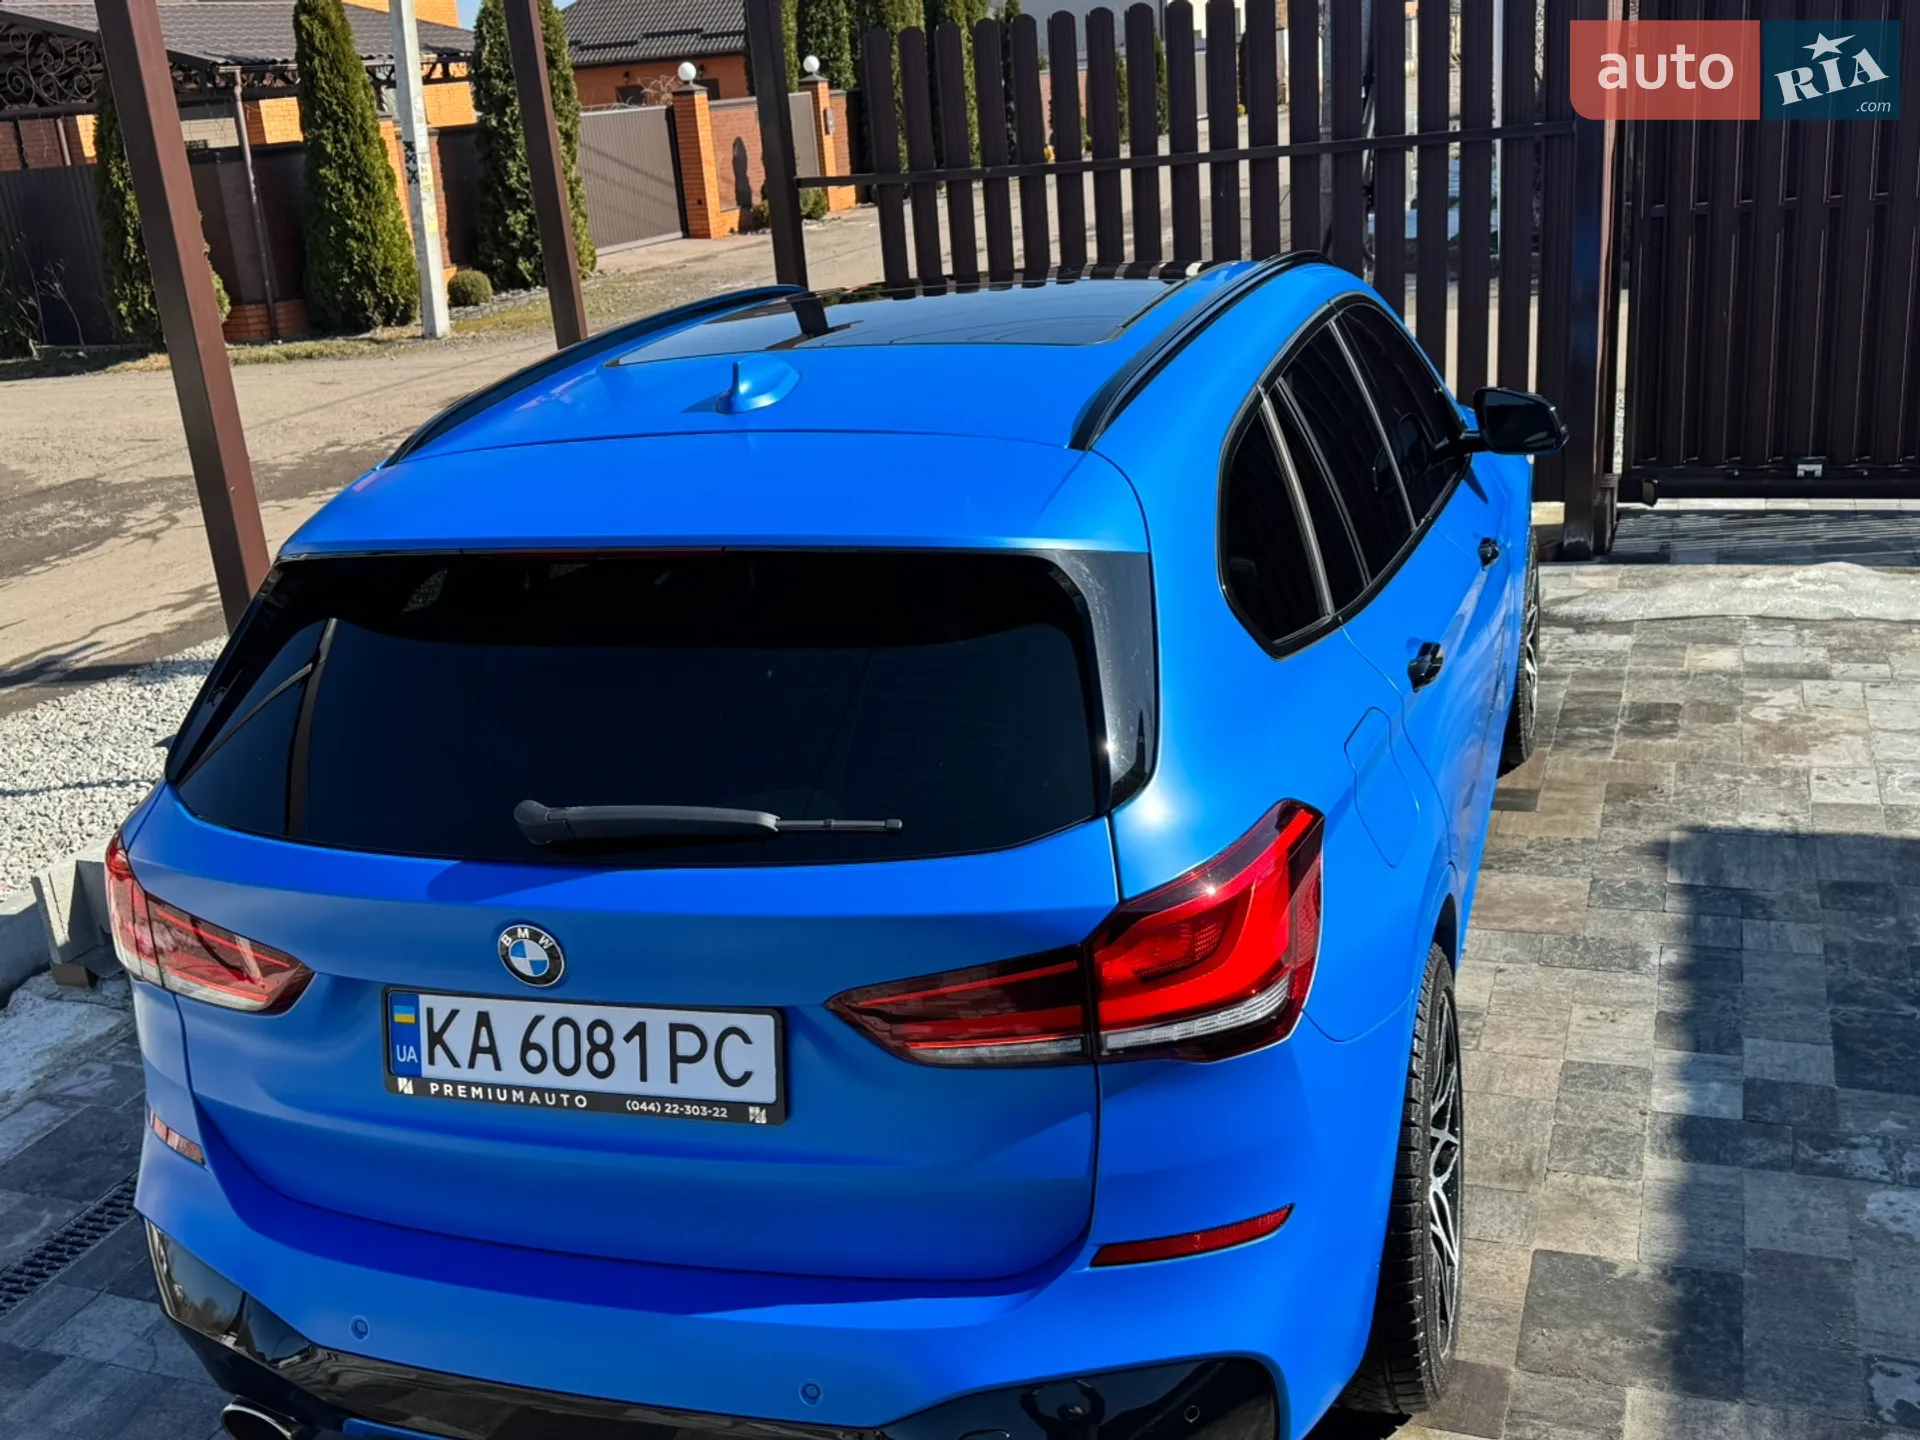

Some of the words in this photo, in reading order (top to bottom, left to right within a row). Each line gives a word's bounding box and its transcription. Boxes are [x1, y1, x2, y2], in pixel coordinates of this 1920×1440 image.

[501, 927, 553, 949] BMW
[396, 1044, 418, 1064] UA
[426, 1006, 502, 1071] KA
[519, 1014, 648, 1083] 6081
[669, 1022, 753, 1088] PC
[429, 1082, 588, 1108] PREMIUMAUTO
[626, 1100, 661, 1113] (044)
[664, 1103, 728, 1118] 22-303-22
